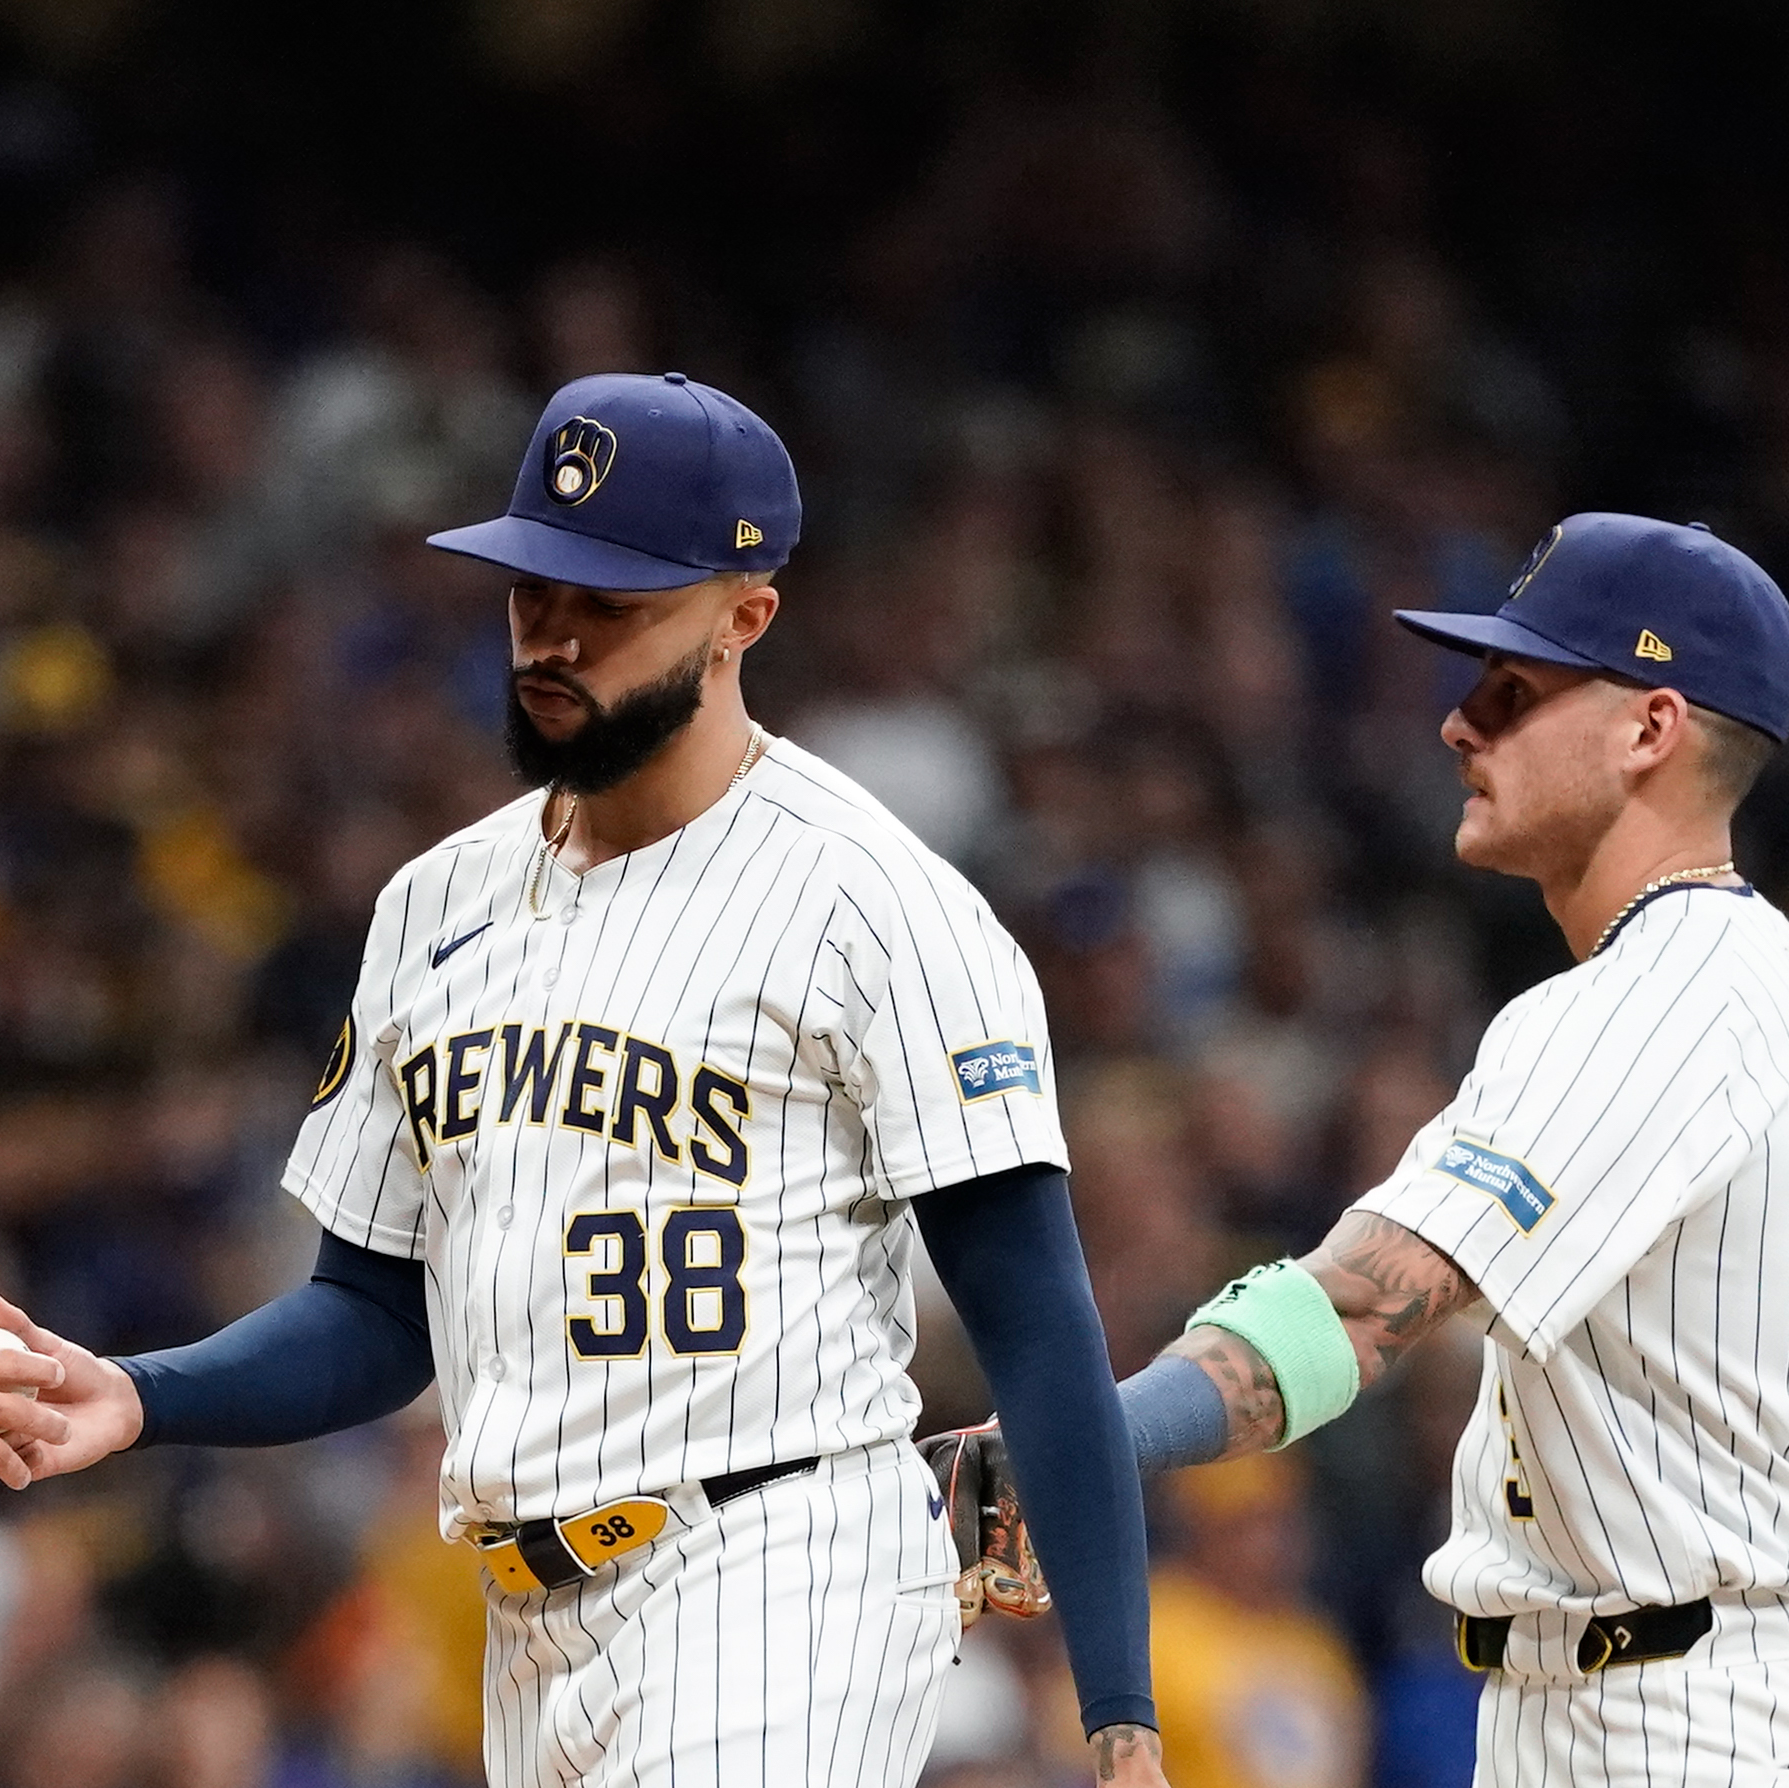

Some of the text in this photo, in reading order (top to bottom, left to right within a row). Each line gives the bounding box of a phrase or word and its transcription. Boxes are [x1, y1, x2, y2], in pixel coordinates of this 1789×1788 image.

[397, 1019, 753, 1192] REWERS
[1464, 1165, 1513, 1193] Mutual
[1472, 1155, 1546, 1215] Northwestern
[564, 1207, 749, 1361] 38
[591, 1515, 635, 1546] 38
